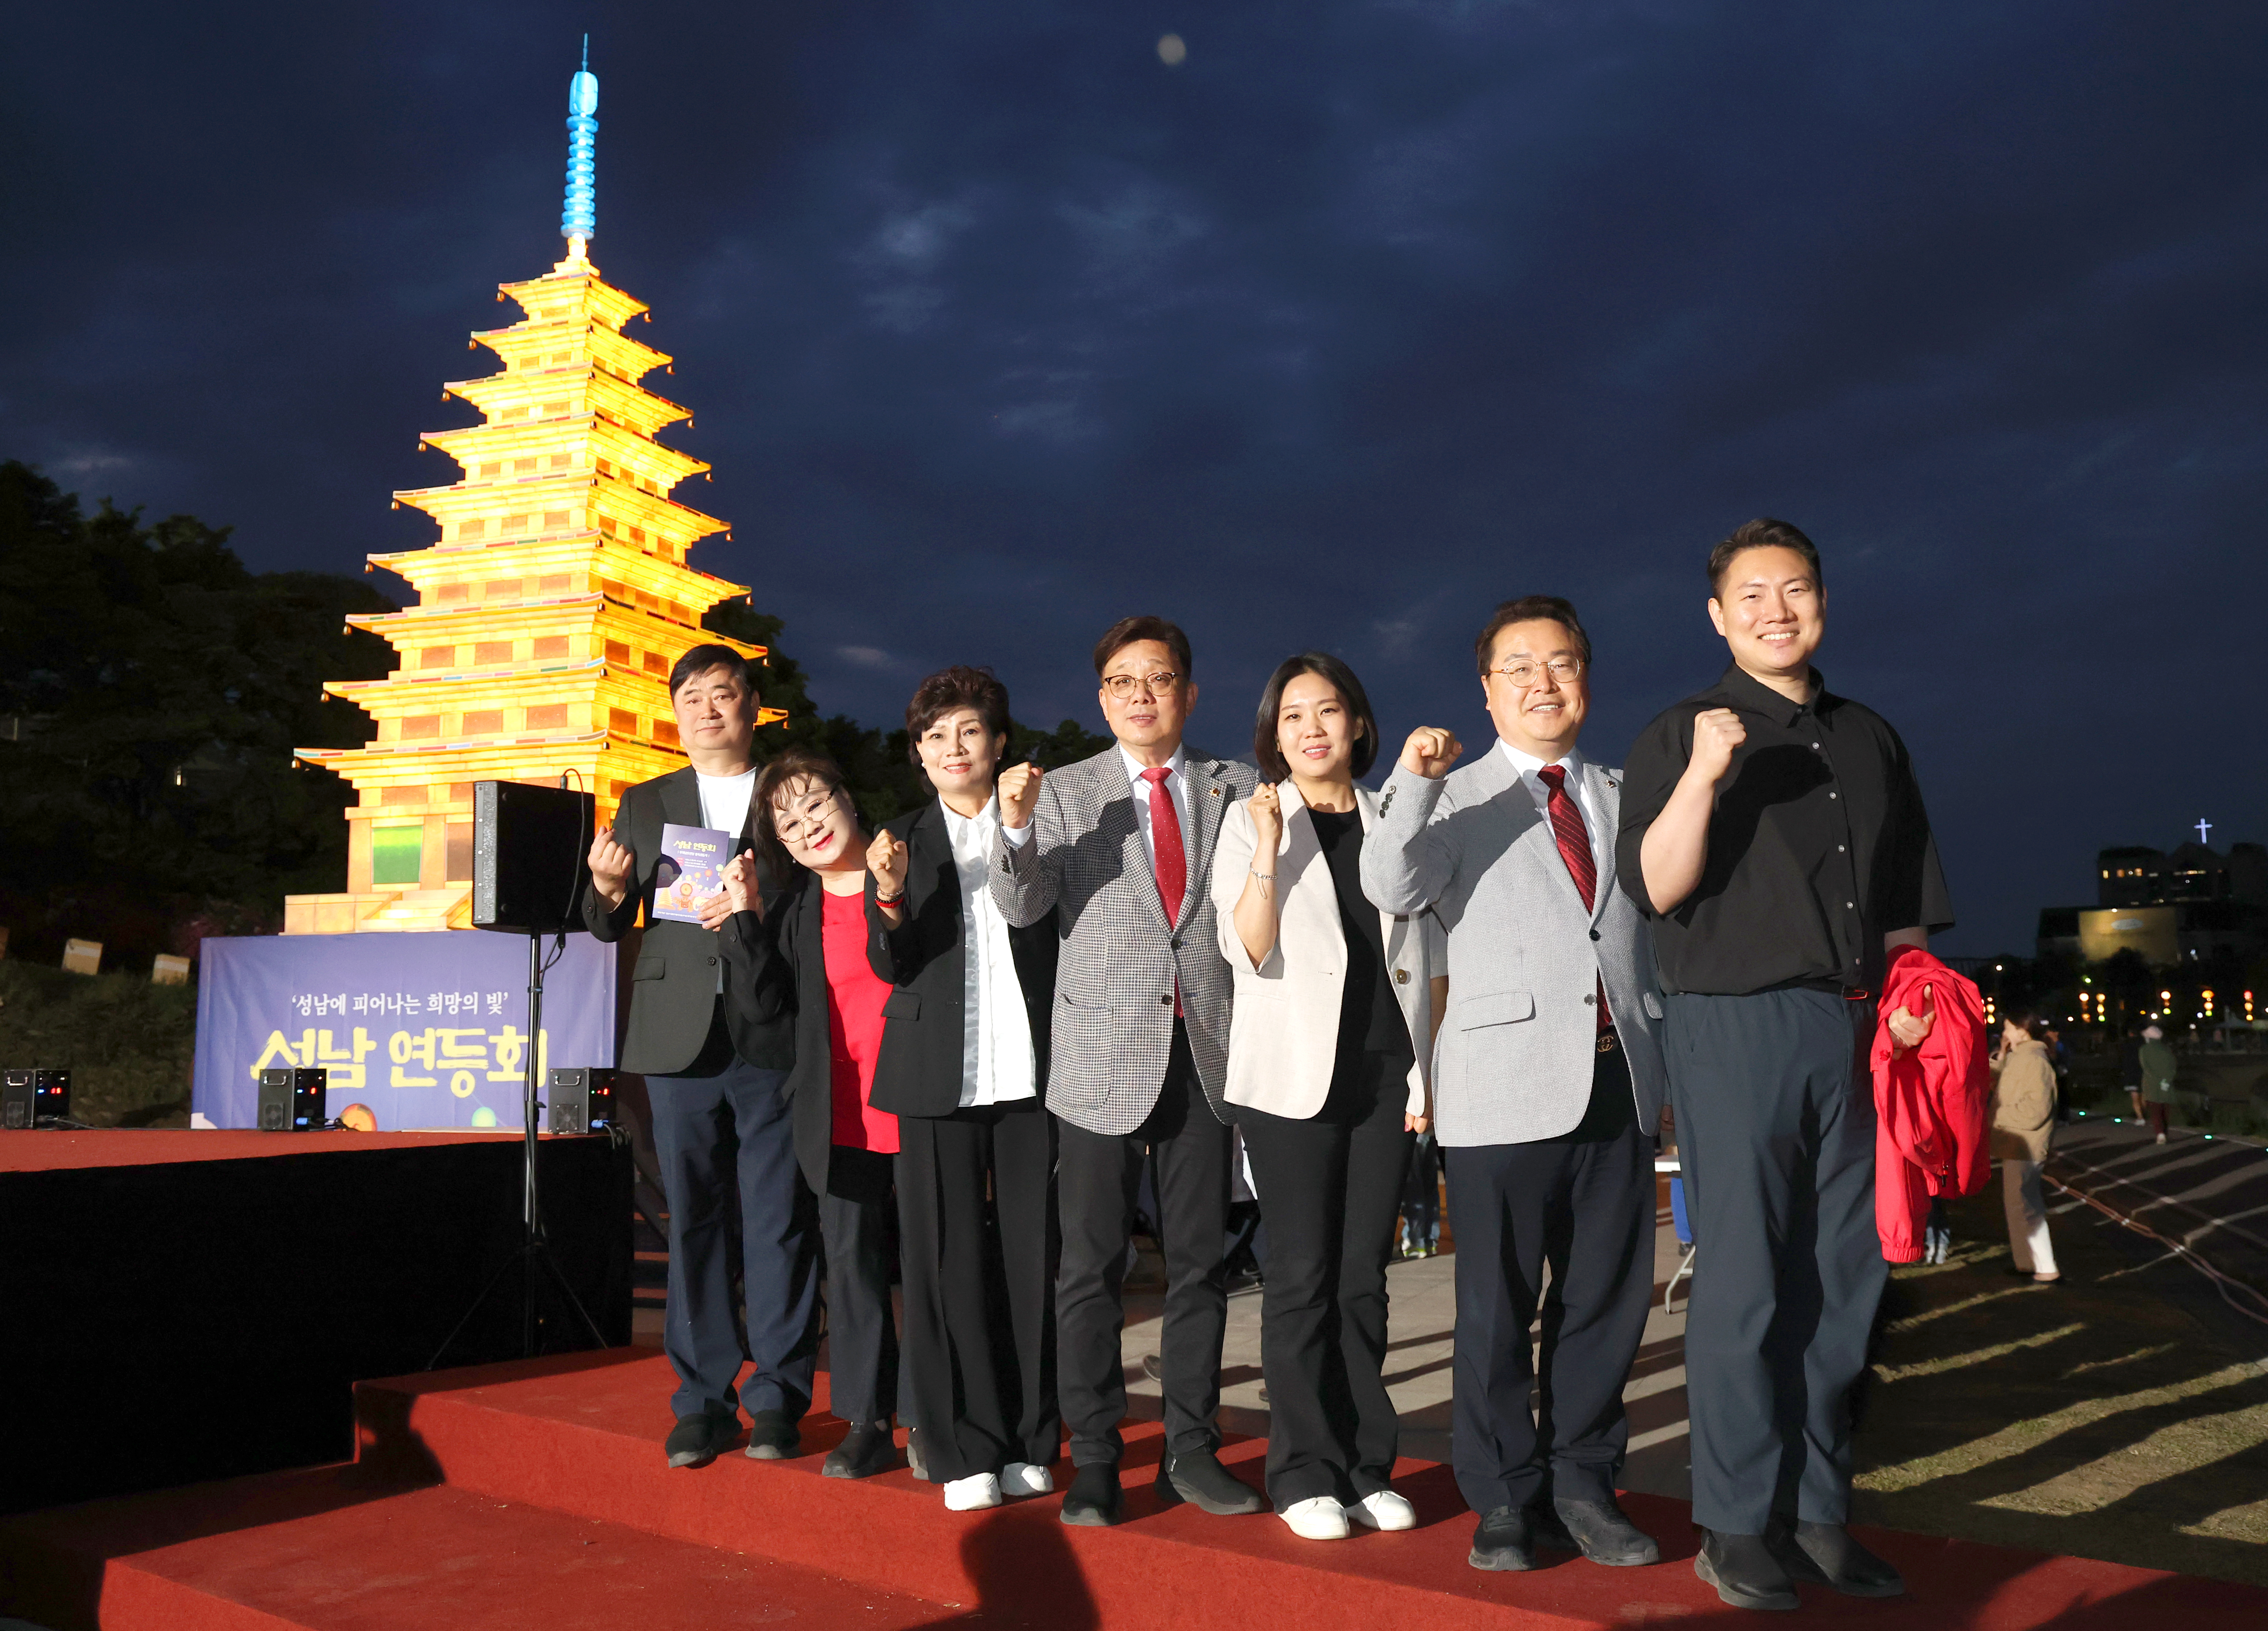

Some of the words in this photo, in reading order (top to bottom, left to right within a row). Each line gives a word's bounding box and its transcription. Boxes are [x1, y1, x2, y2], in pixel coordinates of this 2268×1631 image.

[673, 840, 692, 850] 성남
[693, 843, 716, 853] 연등회
[292, 993, 347, 1016] ‘성남에
[352, 992, 421, 1016] 피어나는
[426, 992, 478, 1015] 희망의
[486, 991, 509, 1015] 빛’
[250, 1026, 377, 1090] 성남
[389, 1025, 548, 1098] 연등회
